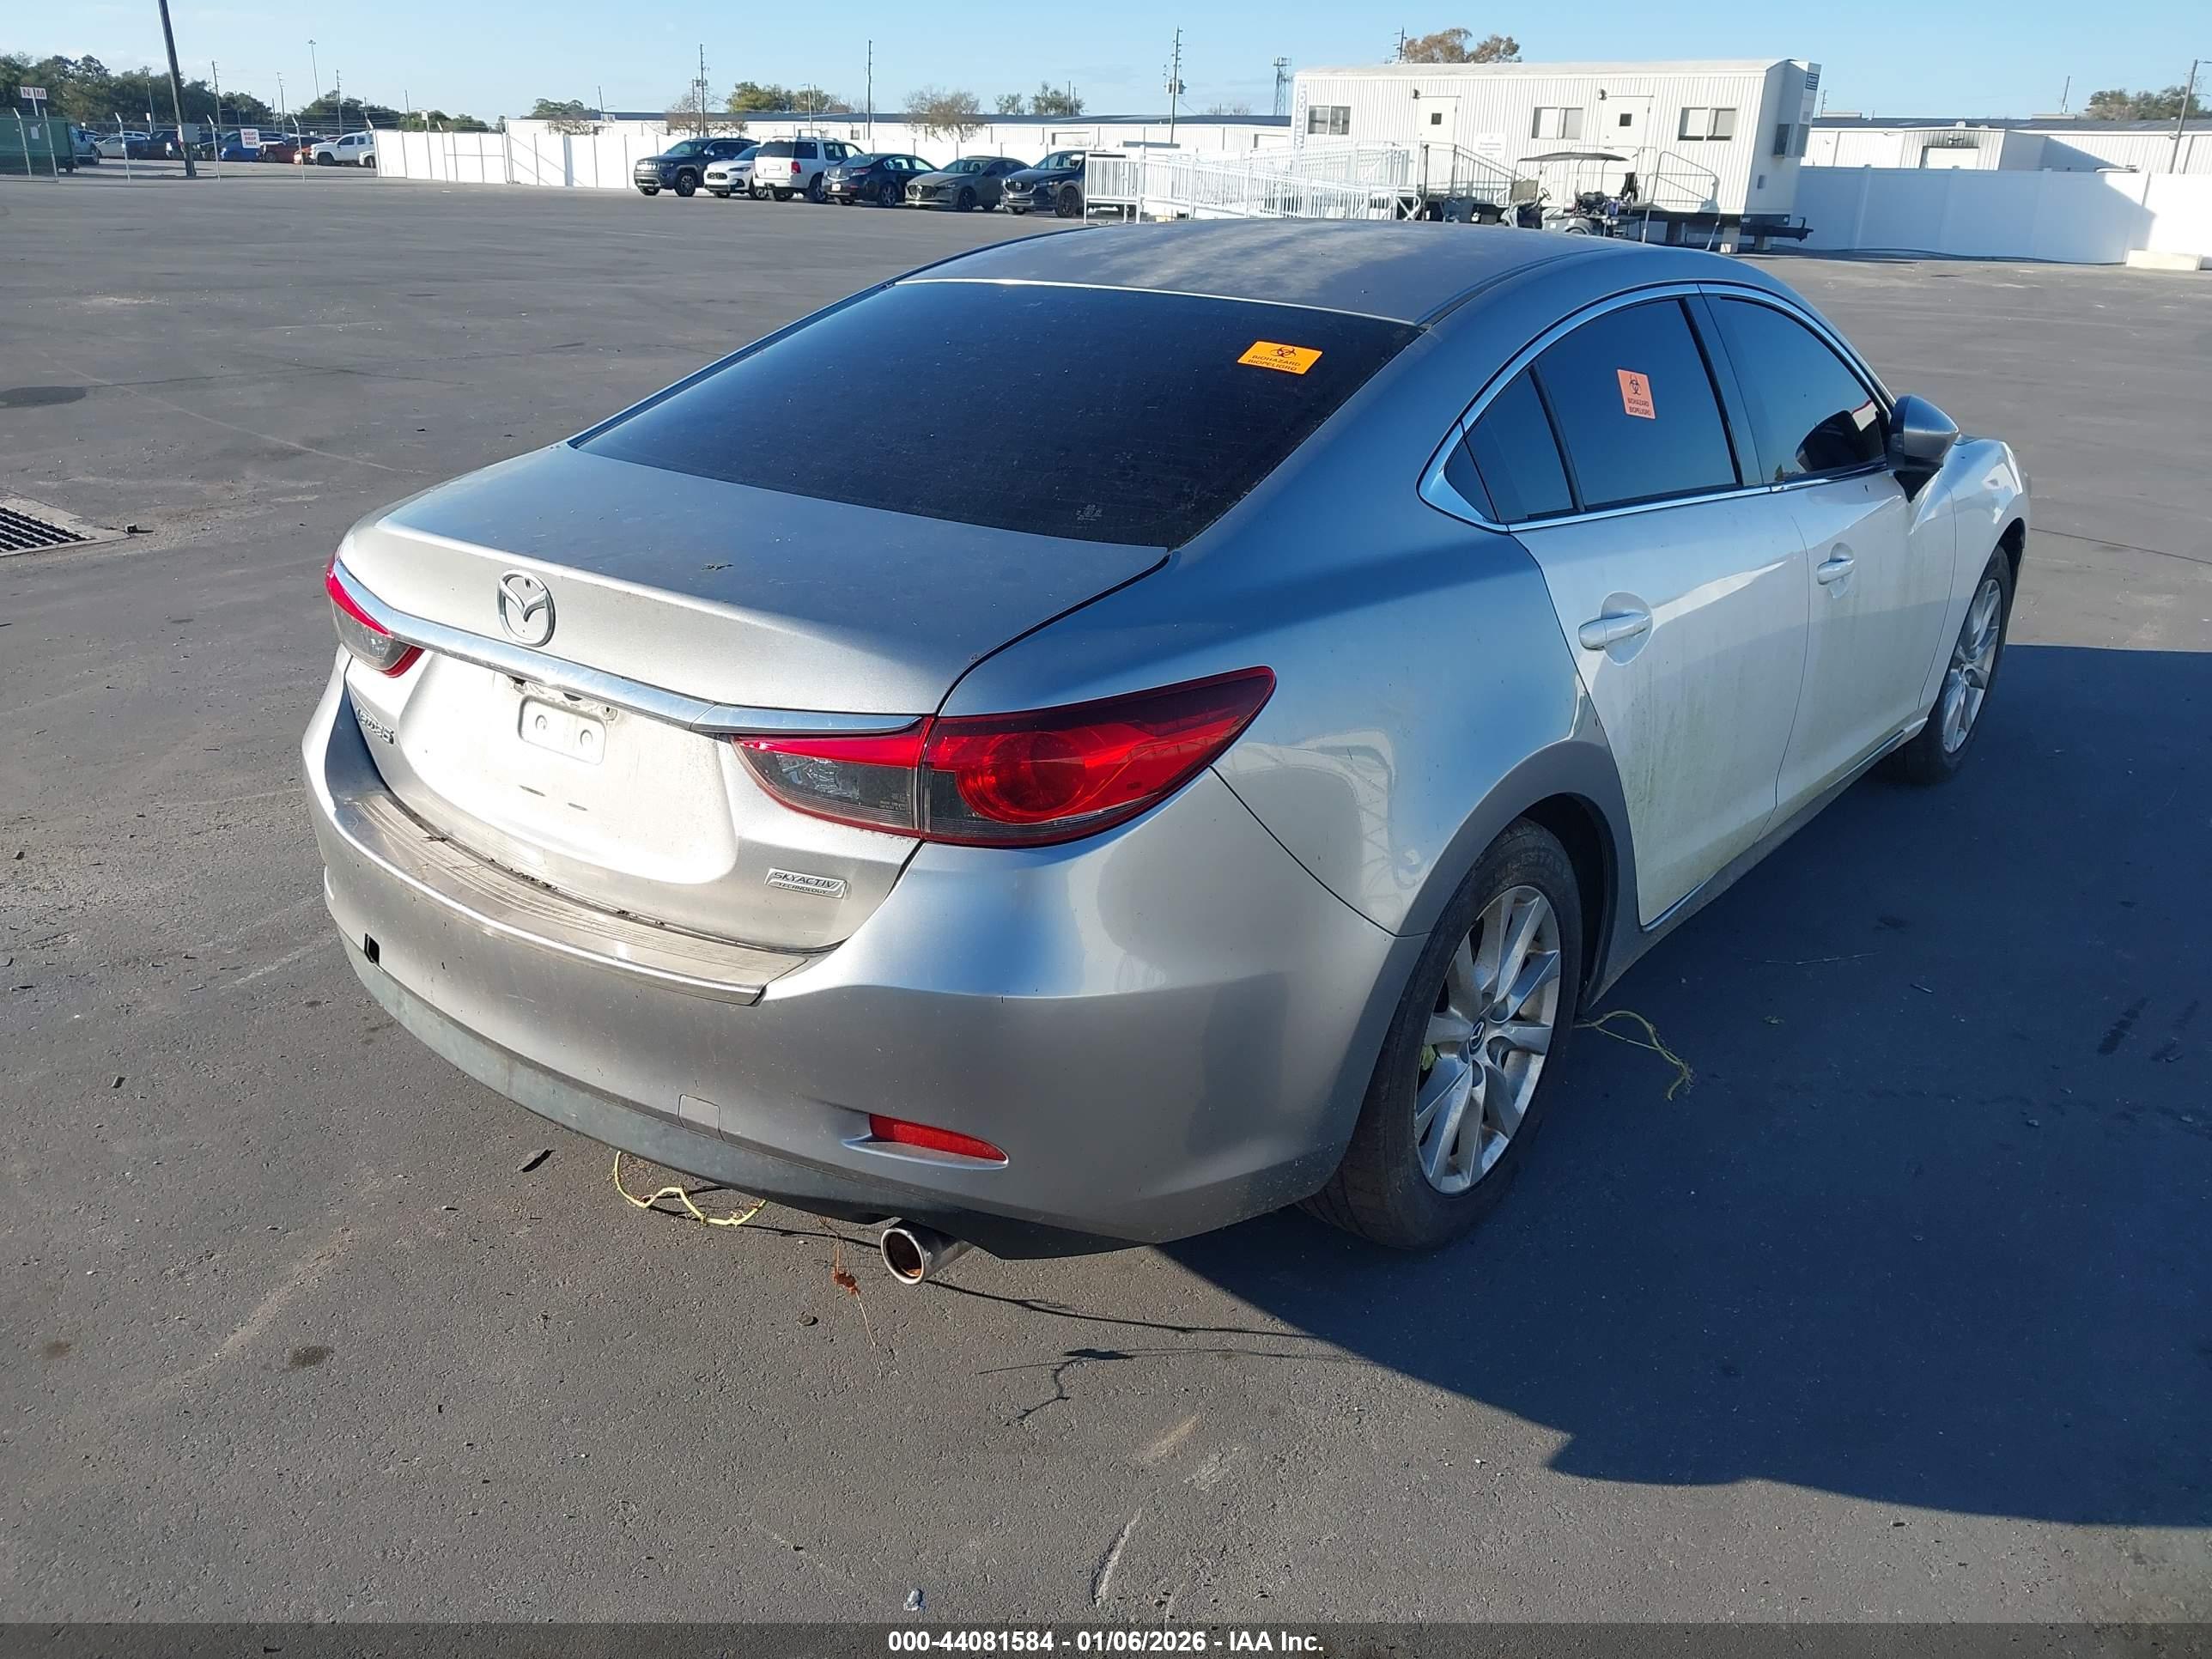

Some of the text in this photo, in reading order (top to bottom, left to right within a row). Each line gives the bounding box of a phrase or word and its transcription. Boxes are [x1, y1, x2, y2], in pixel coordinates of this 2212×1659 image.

[1248, 359, 1297, 371] BIOPELIGRO
[1252, 355, 1301, 367] BIOHAZARD
[1627, 398, 1650, 406] BIOHAZARD
[774, 872, 837, 888] SKYACTIV
[777, 882, 827, 894] TECHNOLOGY
